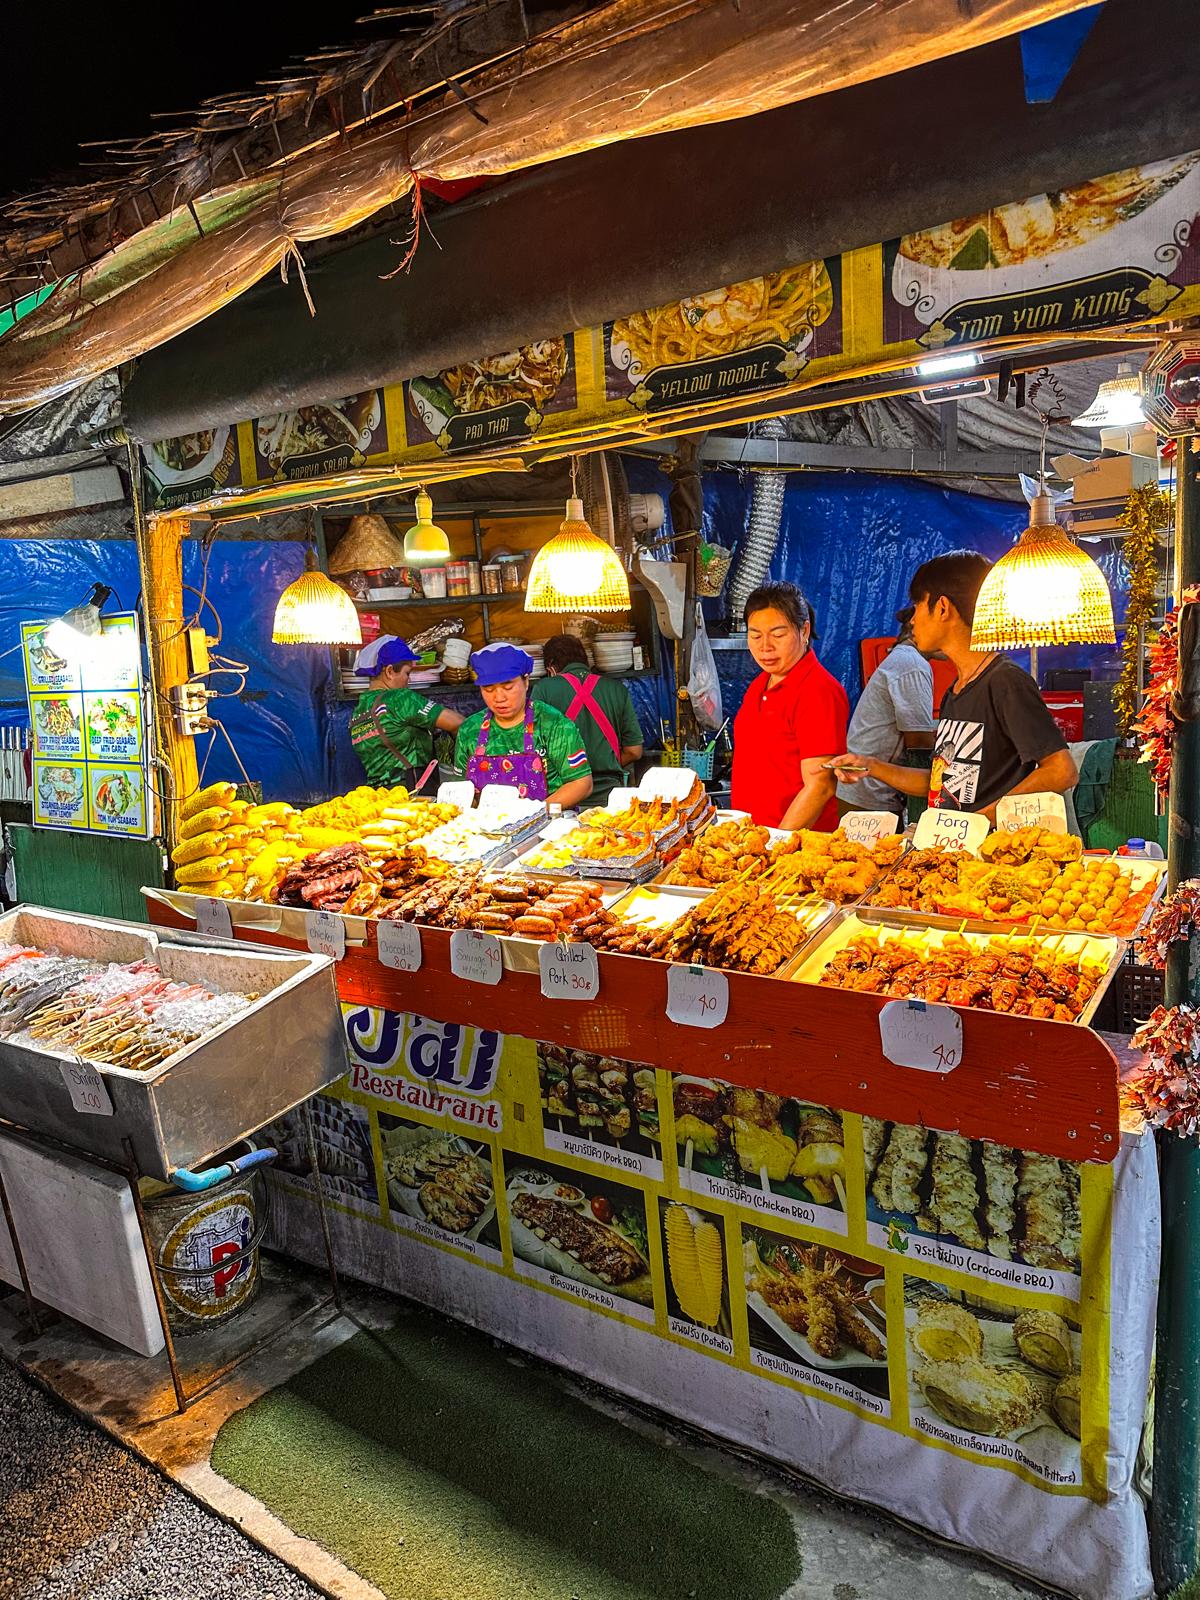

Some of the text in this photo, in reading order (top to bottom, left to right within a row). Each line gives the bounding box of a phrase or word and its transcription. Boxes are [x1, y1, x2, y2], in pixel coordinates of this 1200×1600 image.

[958, 287, 1135, 343] TOM YUM KUNG
[661, 361, 770, 399] YELLOW NOODLE
[465, 417, 510, 440] PAD THAI
[290, 456, 348, 480] PAPAYA SALAD
[963, 780, 974, 803] WHITE
[1014, 797, 1043, 817] Fried
[849, 815, 882, 833] Crispy
[935, 812, 969, 840] Forg
[380, 940, 415, 957] Crocodile
[548, 967, 569, 985] Pork
[698, 994, 717, 1016] 40
[932, 1044, 956, 1071] 40
[81, 1091, 102, 1109] 100
[351, 1062, 500, 1128] Restaurant
[603, 1150, 622, 1165] (Pork
[753, 1194, 791, 1215] (Chicken
[966, 1256, 1022, 1283] (crocodile
[581, 1287, 600, 1302] (Pork
[600, 1295, 614, 1309] Rib)
[701, 1332, 733, 1355] (Potato)
[812, 1373, 834, 1392] (Deep
[834, 1383, 854, 1398] Fried
[855, 1391, 884, 1414] Shrimp)
[1015, 1448, 1043, 1475] (Banana
